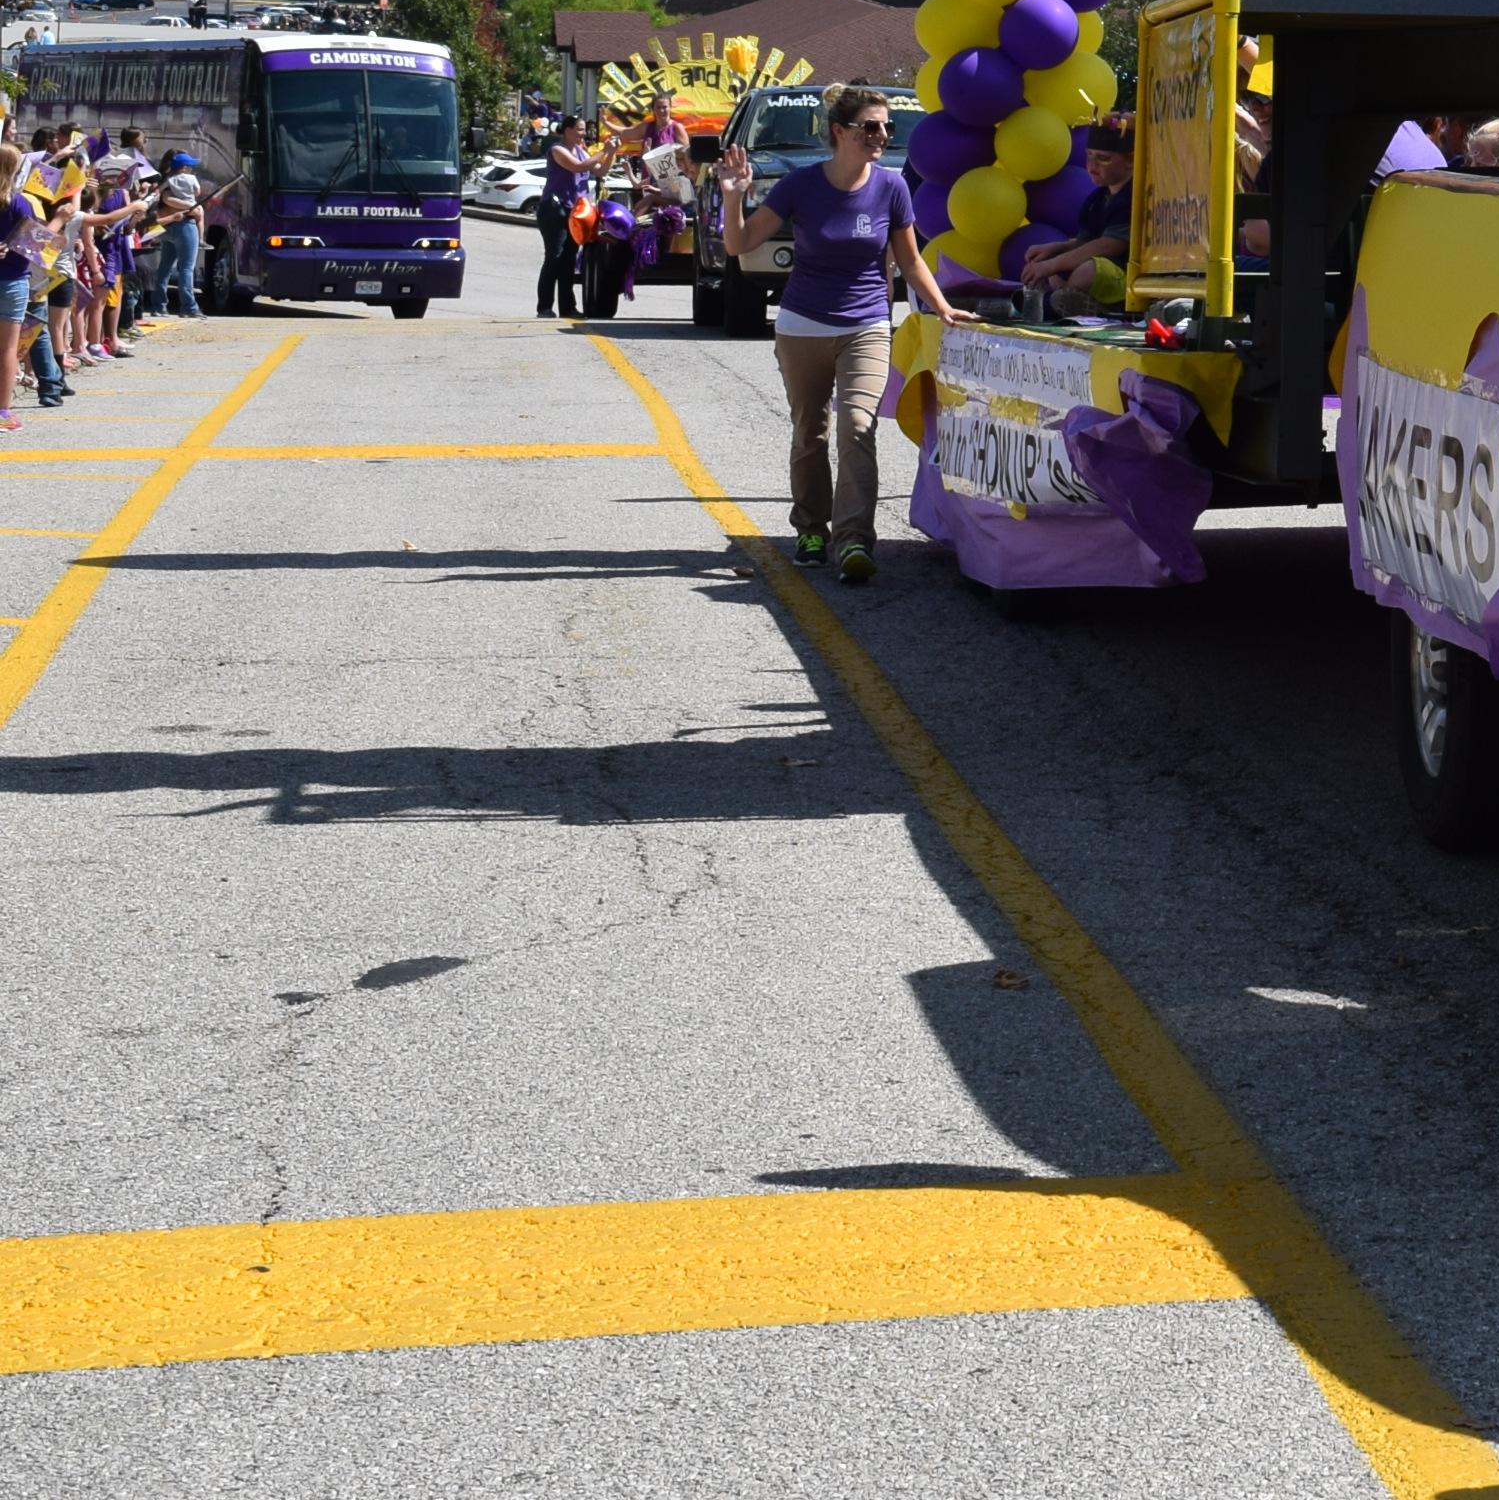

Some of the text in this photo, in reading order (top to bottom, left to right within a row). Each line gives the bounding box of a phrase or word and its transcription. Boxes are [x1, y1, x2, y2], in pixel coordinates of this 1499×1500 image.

[309, 52, 417, 69] CAMDENTON
[106, 64, 157, 102] LAKERS
[160, 62, 230, 104] FOOTBALL
[680, 64, 721, 90] and
[766, 94, 821, 108] What's
[316, 205, 423, 218] LAKER FOOTBALL
[323, 259, 423, 275] Purple Haze
